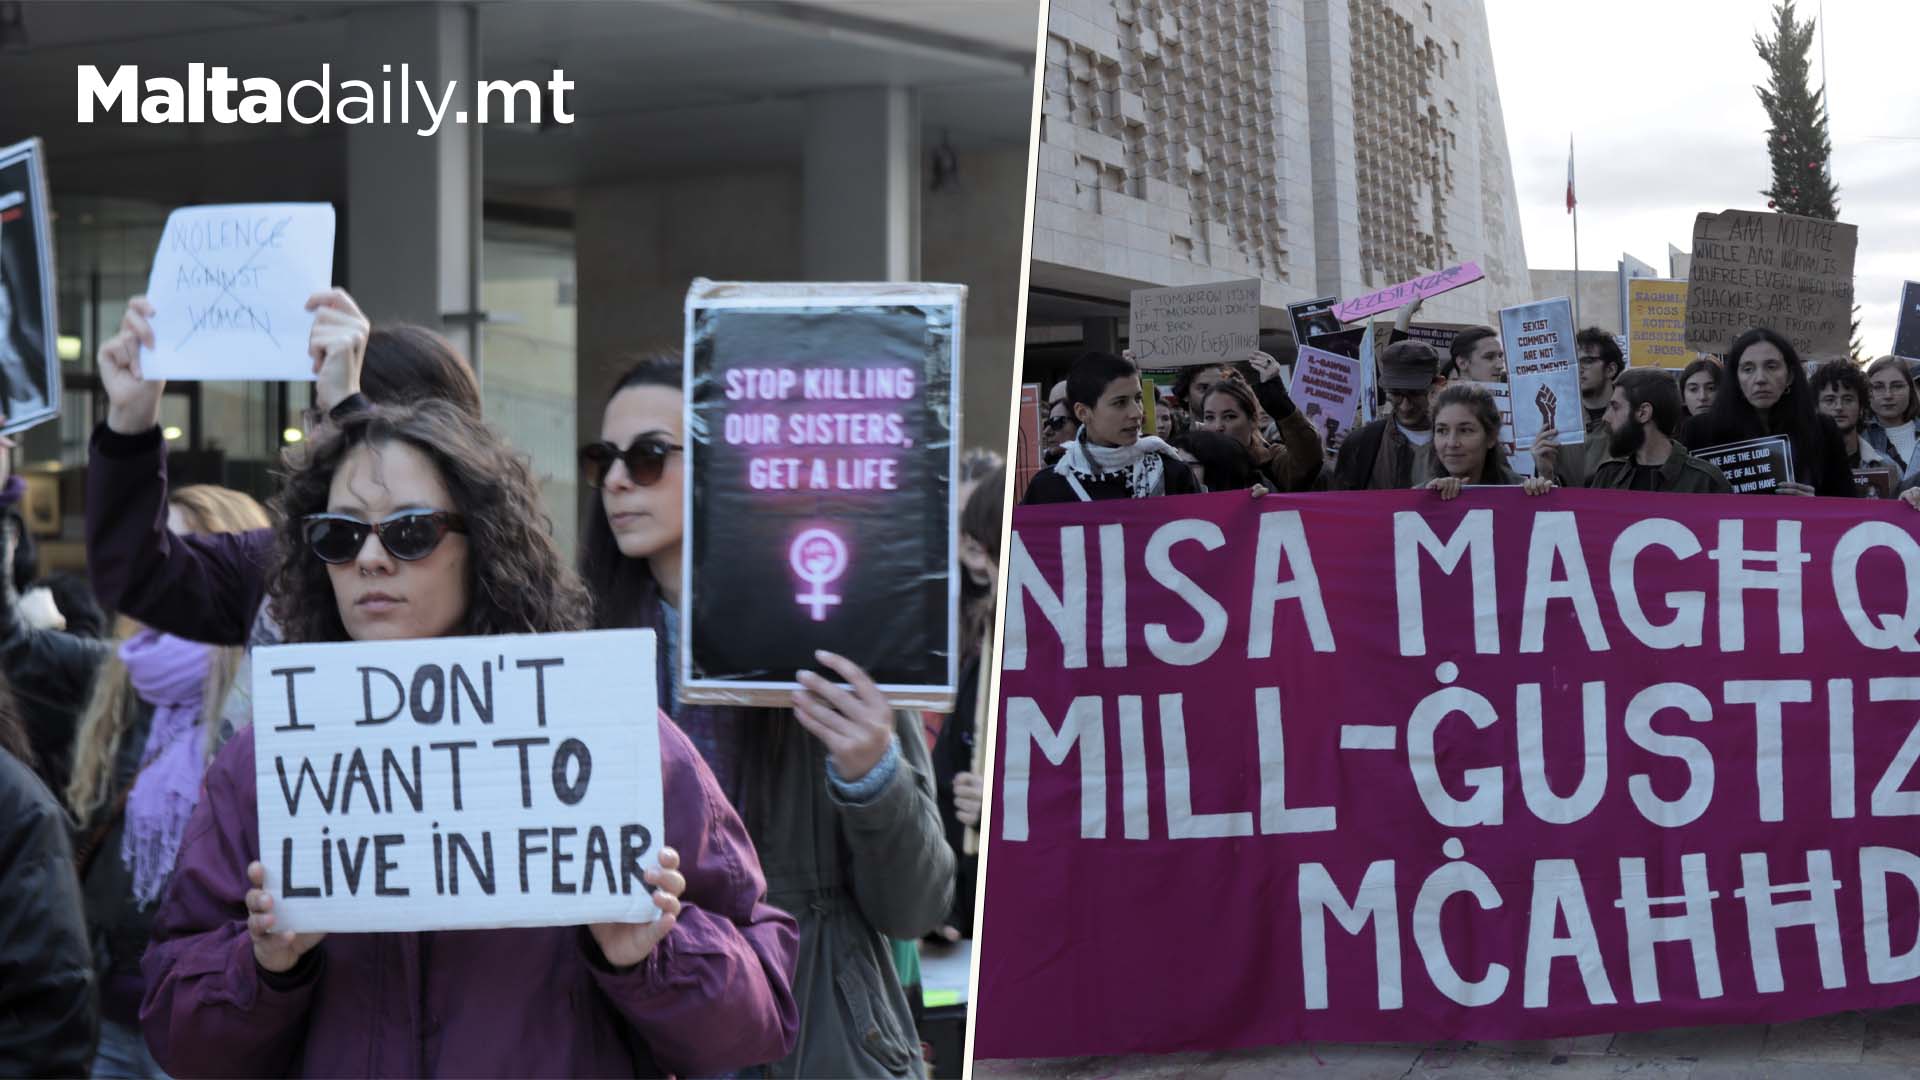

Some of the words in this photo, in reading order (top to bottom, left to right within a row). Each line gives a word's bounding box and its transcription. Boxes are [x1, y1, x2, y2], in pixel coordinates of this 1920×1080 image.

[1695, 215, 1719, 241] I
[1729, 215, 1764, 243] AM
[1777, 217, 1801, 246] NOT
[1804, 220, 1838, 252] FREE
[1694, 241, 1742, 263] WHILE
[1747, 246, 1775, 266] ANY
[1823, 258, 1840, 275] IS
[176, 264, 267, 289] AGAINST
[1754, 269, 1792, 289] EVEN
[1152, 304, 1217, 319] TOMORROW
[1691, 287, 1762, 311] SHACKLES
[1768, 293, 1792, 313] ARE
[1796, 298, 1824, 316] VERY
[186, 304, 272, 330] WOMEN
[1166, 321, 1194, 334] BACK
[1522, 319, 1548, 332] SEXIST
[1689, 310, 1777, 329] DIFFERENT
[1135, 333, 1198, 359] DESTROY
[1518, 332, 1558, 347] COMMENTS
[1523, 350, 1538, 361] ARE
[1539, 347, 1554, 359] NOT
[1516, 360, 1568, 376] COMPLIMENTS
[725, 368, 797, 400] STOP
[804, 367, 915, 400] KILLING
[725, 413, 780, 446] OUR
[789, 413, 914, 448] SISTERS,
[1723, 453, 1737, 465] ARE
[1737, 450, 1751, 462] THE
[1752, 448, 1770, 460] LOUD
[749, 458, 801, 490] GET
[810, 458, 828, 489] A
[837, 458, 897, 490] LIFE
[1734, 467, 1743, 478] OF
[1744, 466, 1757, 477] ALL
[1757, 464, 1771, 475] THE
[1741, 480, 1757, 493] WHO
[1758, 478, 1776, 490] HAVE
[1003, 510, 1336, 670] NISA
[271, 666, 316, 731] I
[355, 654, 565, 727] DON'T
[276, 740, 477, 817] WANT
[492, 737, 592, 809] TO
[518, 824, 657, 895] FEAR
